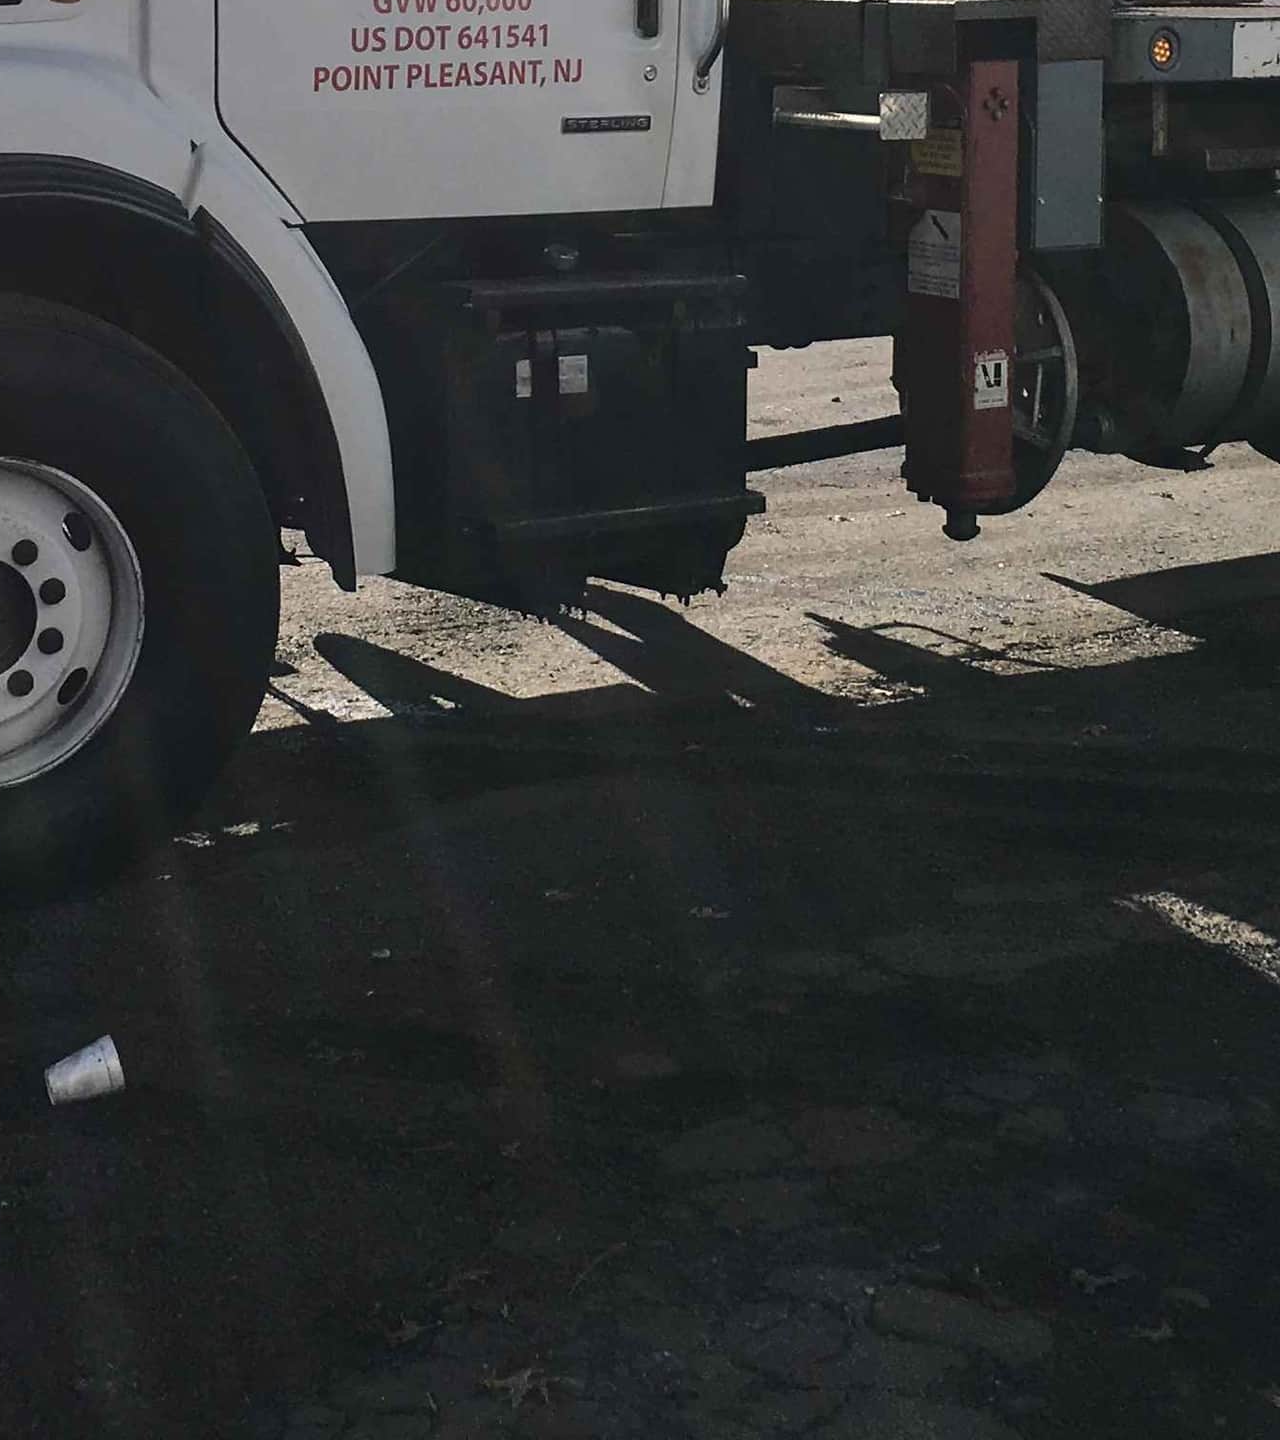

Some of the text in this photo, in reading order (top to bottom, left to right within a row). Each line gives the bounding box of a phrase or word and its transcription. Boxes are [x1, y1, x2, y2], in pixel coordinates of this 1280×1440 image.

[351, 23, 550, 53] US DOT 641541
[312, 57, 585, 93] POINT PLEASANT, NJ
